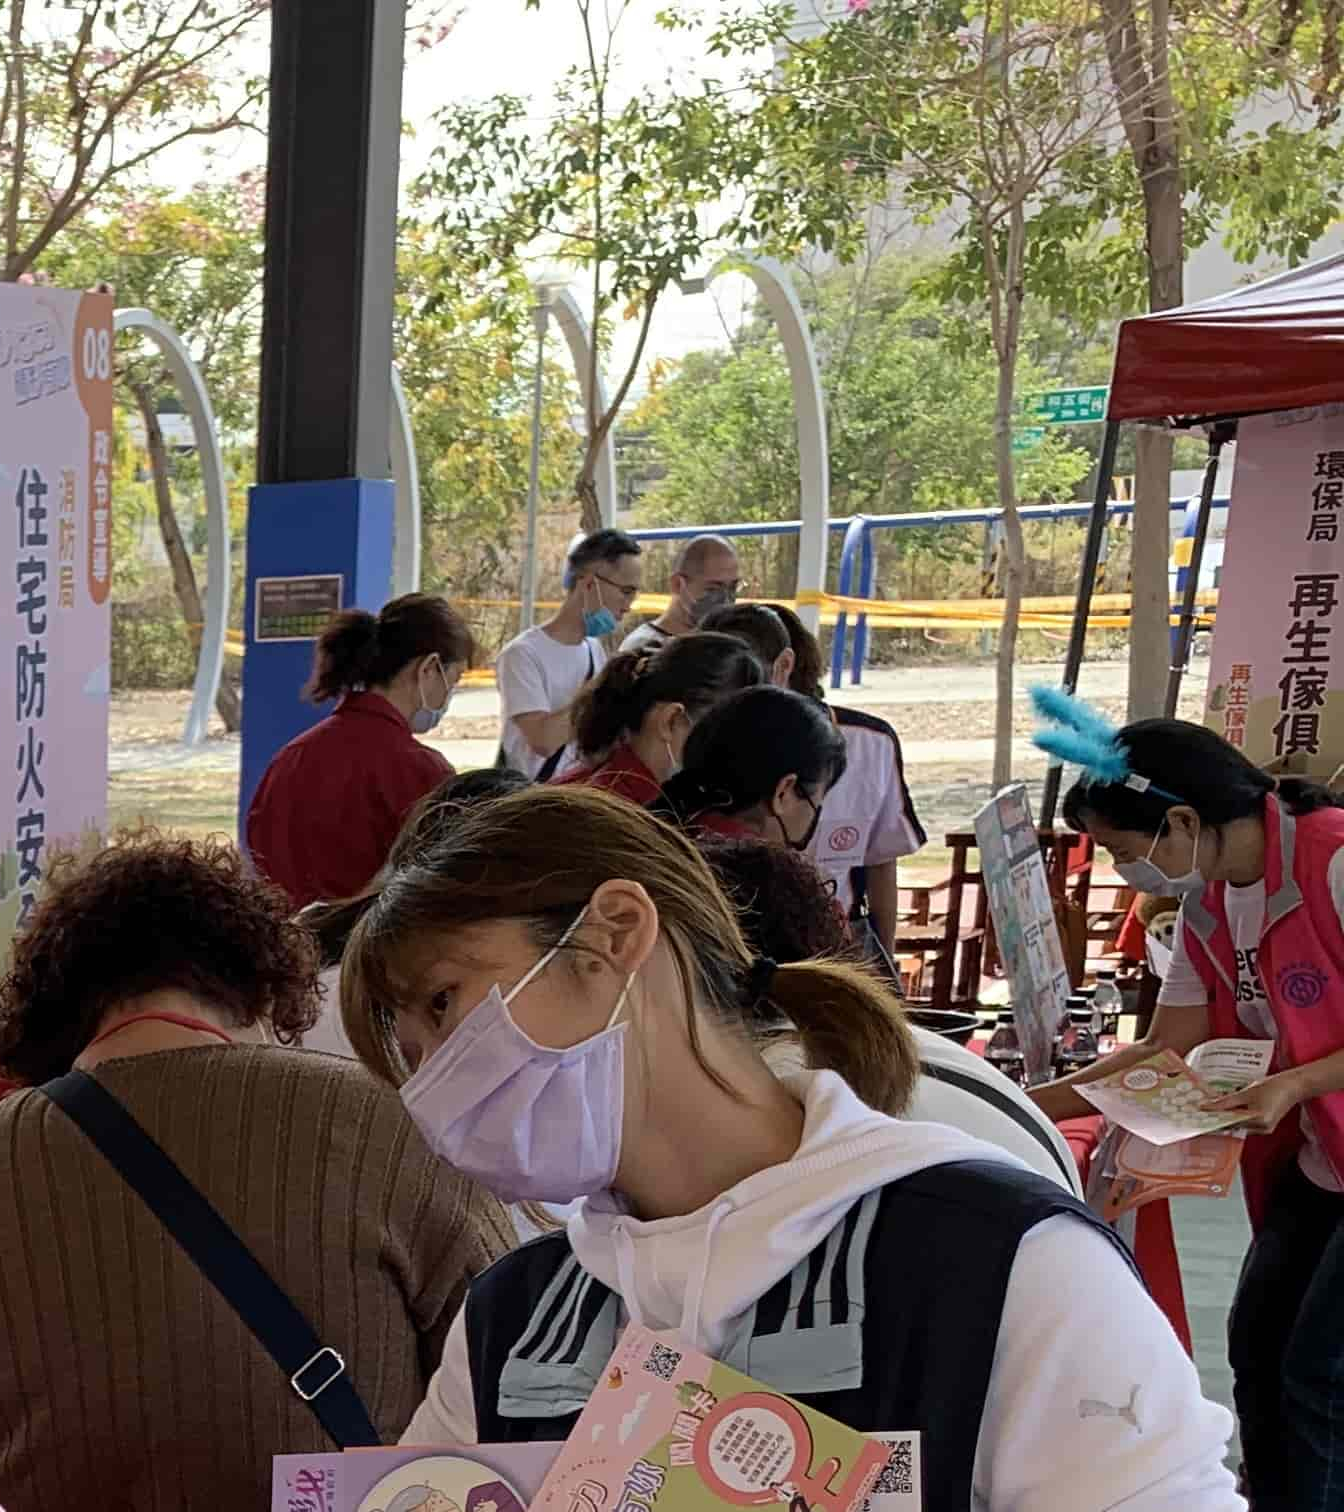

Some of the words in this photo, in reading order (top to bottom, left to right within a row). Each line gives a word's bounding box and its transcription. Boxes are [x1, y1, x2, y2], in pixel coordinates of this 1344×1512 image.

[81, 327, 111, 381] 08
[1305, 452, 1344, 543] 環保局
[1223, 663, 1253, 748] 再生傢俱
[1274, 573, 1340, 757] 再生傢俱
